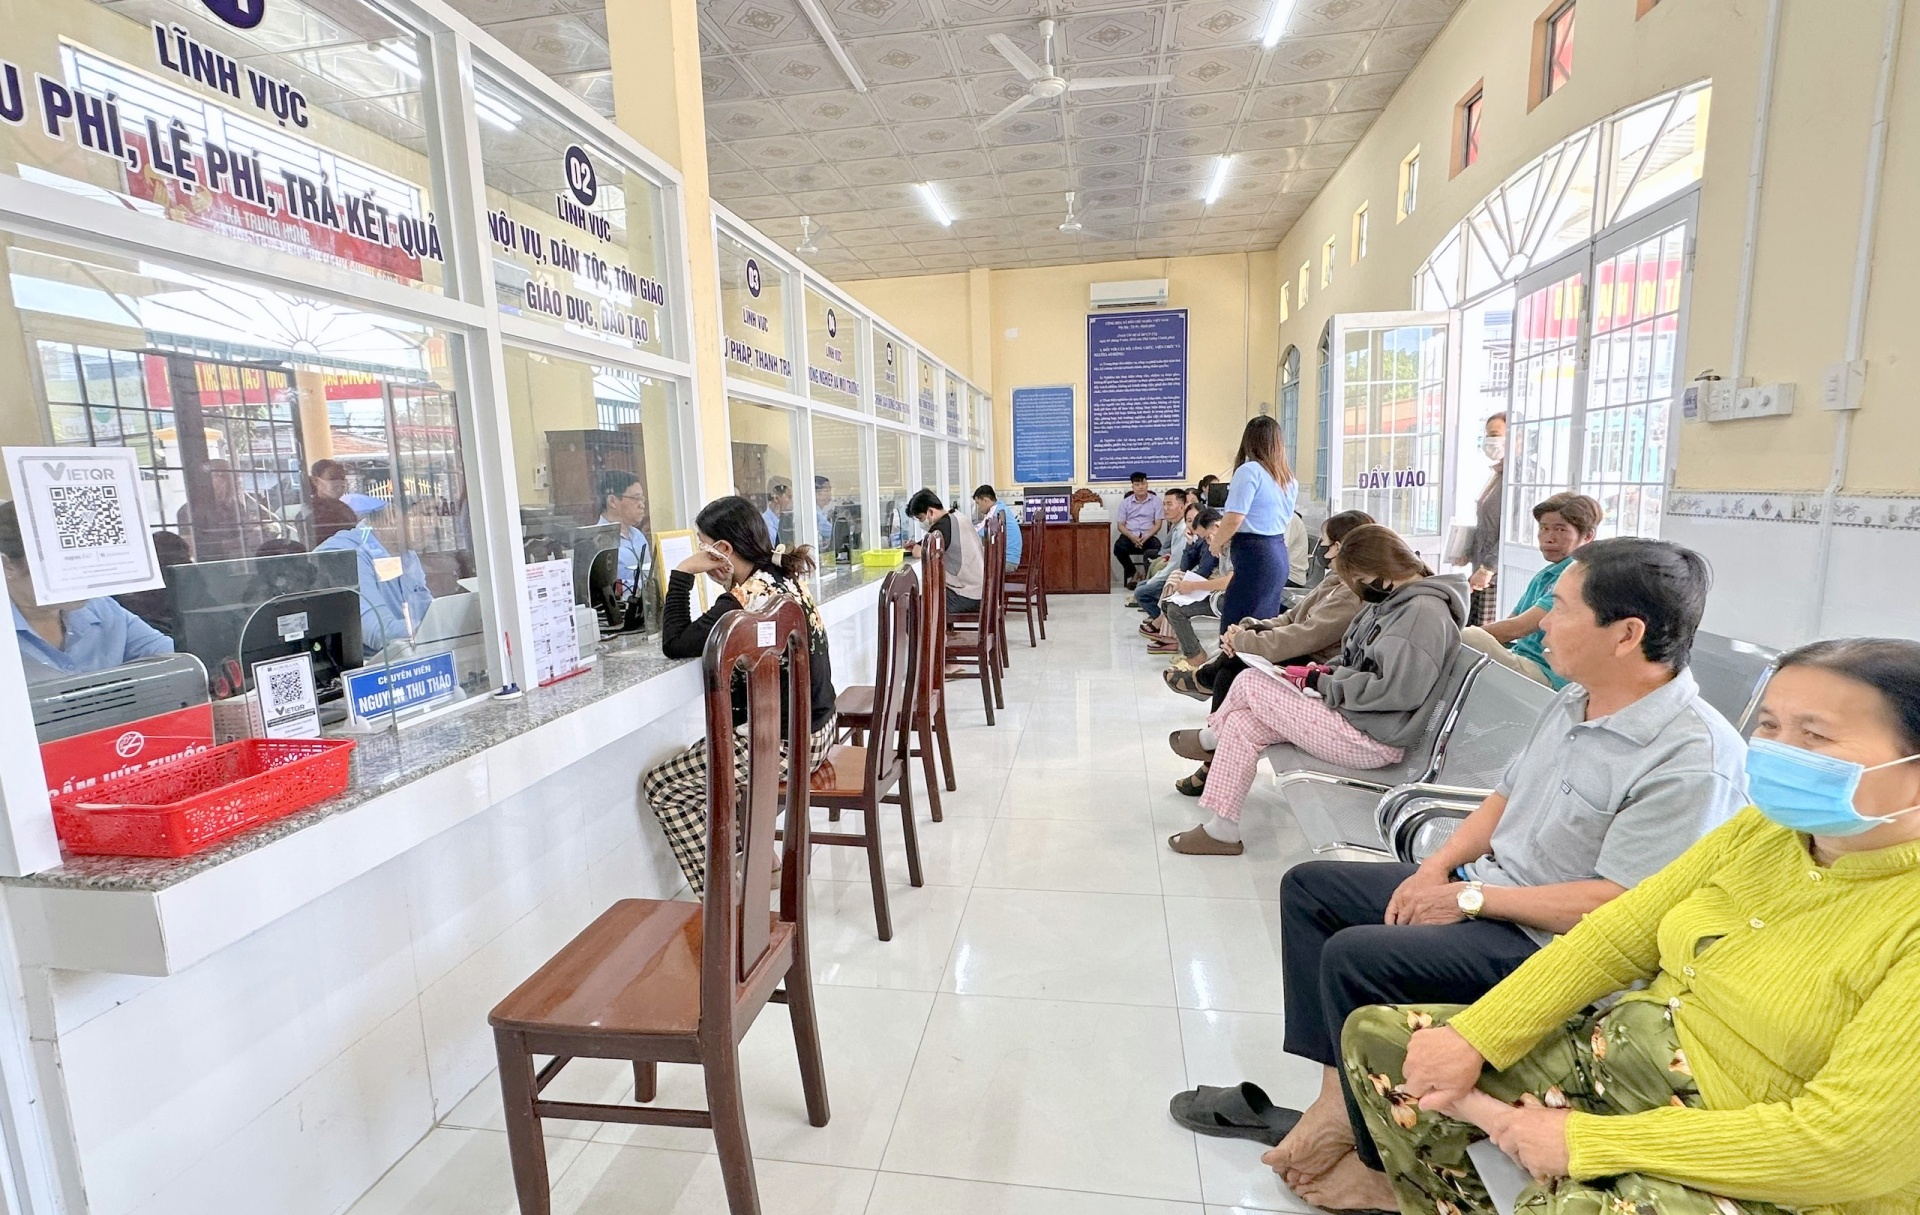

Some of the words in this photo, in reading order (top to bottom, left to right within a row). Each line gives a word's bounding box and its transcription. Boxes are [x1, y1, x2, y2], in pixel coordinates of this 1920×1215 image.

[155, 25, 240, 99] LĨNH
[248, 69, 308, 128] VỰC
[40, 77, 137, 168] PHÍ,
[146, 119, 196, 192] LỆ
[205, 142, 276, 213] PHÍ,
[281, 172, 340, 229] TRẢ
[345, 188, 390, 245] KẾT
[400, 213, 443, 261] QUẢ
[570, 157, 592, 196] 02
[243, 211, 280, 237] TRUNG
[557, 196, 586, 231] LĨNH
[589, 212, 611, 243] VỰC
[488, 212, 516, 252] NỘI
[521, 226, 547, 265] VỤ,
[551, 240, 580, 275] DÂN
[584, 254, 612, 290] TỘC,
[615, 266, 637, 297] TÔN
[641, 278, 663, 306] GIÁO
[749, 267, 759, 290] 03
[526, 282, 562, 316] GIÁO
[567, 296, 598, 330] DỤC,
[601, 302, 625, 335] ĐÀO
[627, 315, 648, 344] TẠO
[755, 349, 778, 373] THANH
[780, 359, 791, 377] TRA
[42, 462, 116, 481] VIETQR
[1359, 466, 1389, 489] ĐẨY
[1395, 467, 1425, 487] VÀO
[414, 664, 431, 675] VIÊN
[406, 683, 425, 699] THU
[427, 671, 451, 693] THẢO
[275, 704, 305, 715] VIETQR
